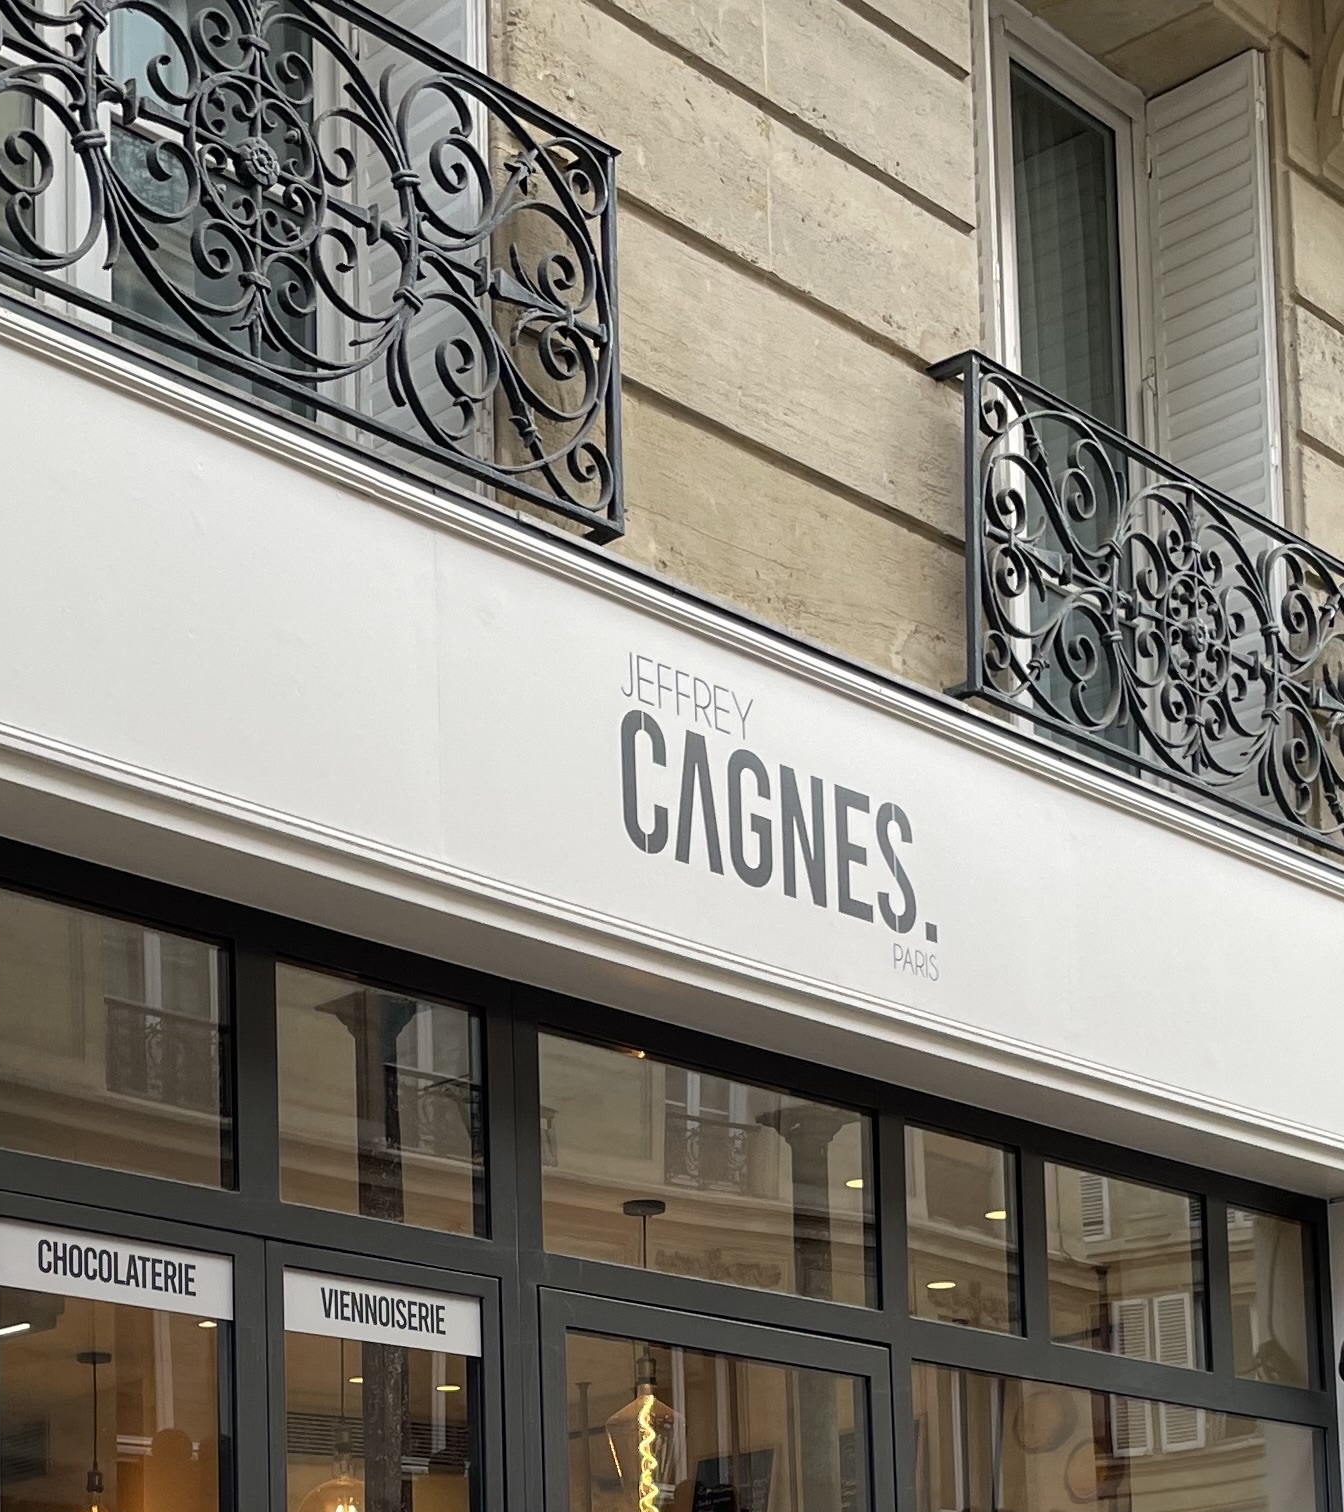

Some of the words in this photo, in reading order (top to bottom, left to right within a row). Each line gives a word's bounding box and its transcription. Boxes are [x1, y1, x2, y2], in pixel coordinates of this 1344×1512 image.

[621, 651, 754, 740] JEFFREY
[620, 709, 938, 944] CAGNES.
[892, 943, 940, 982] PARIS
[36, 1238, 197, 1298] CHOCOLATERIE
[320, 1286, 447, 1336] VIENNOISERIE
